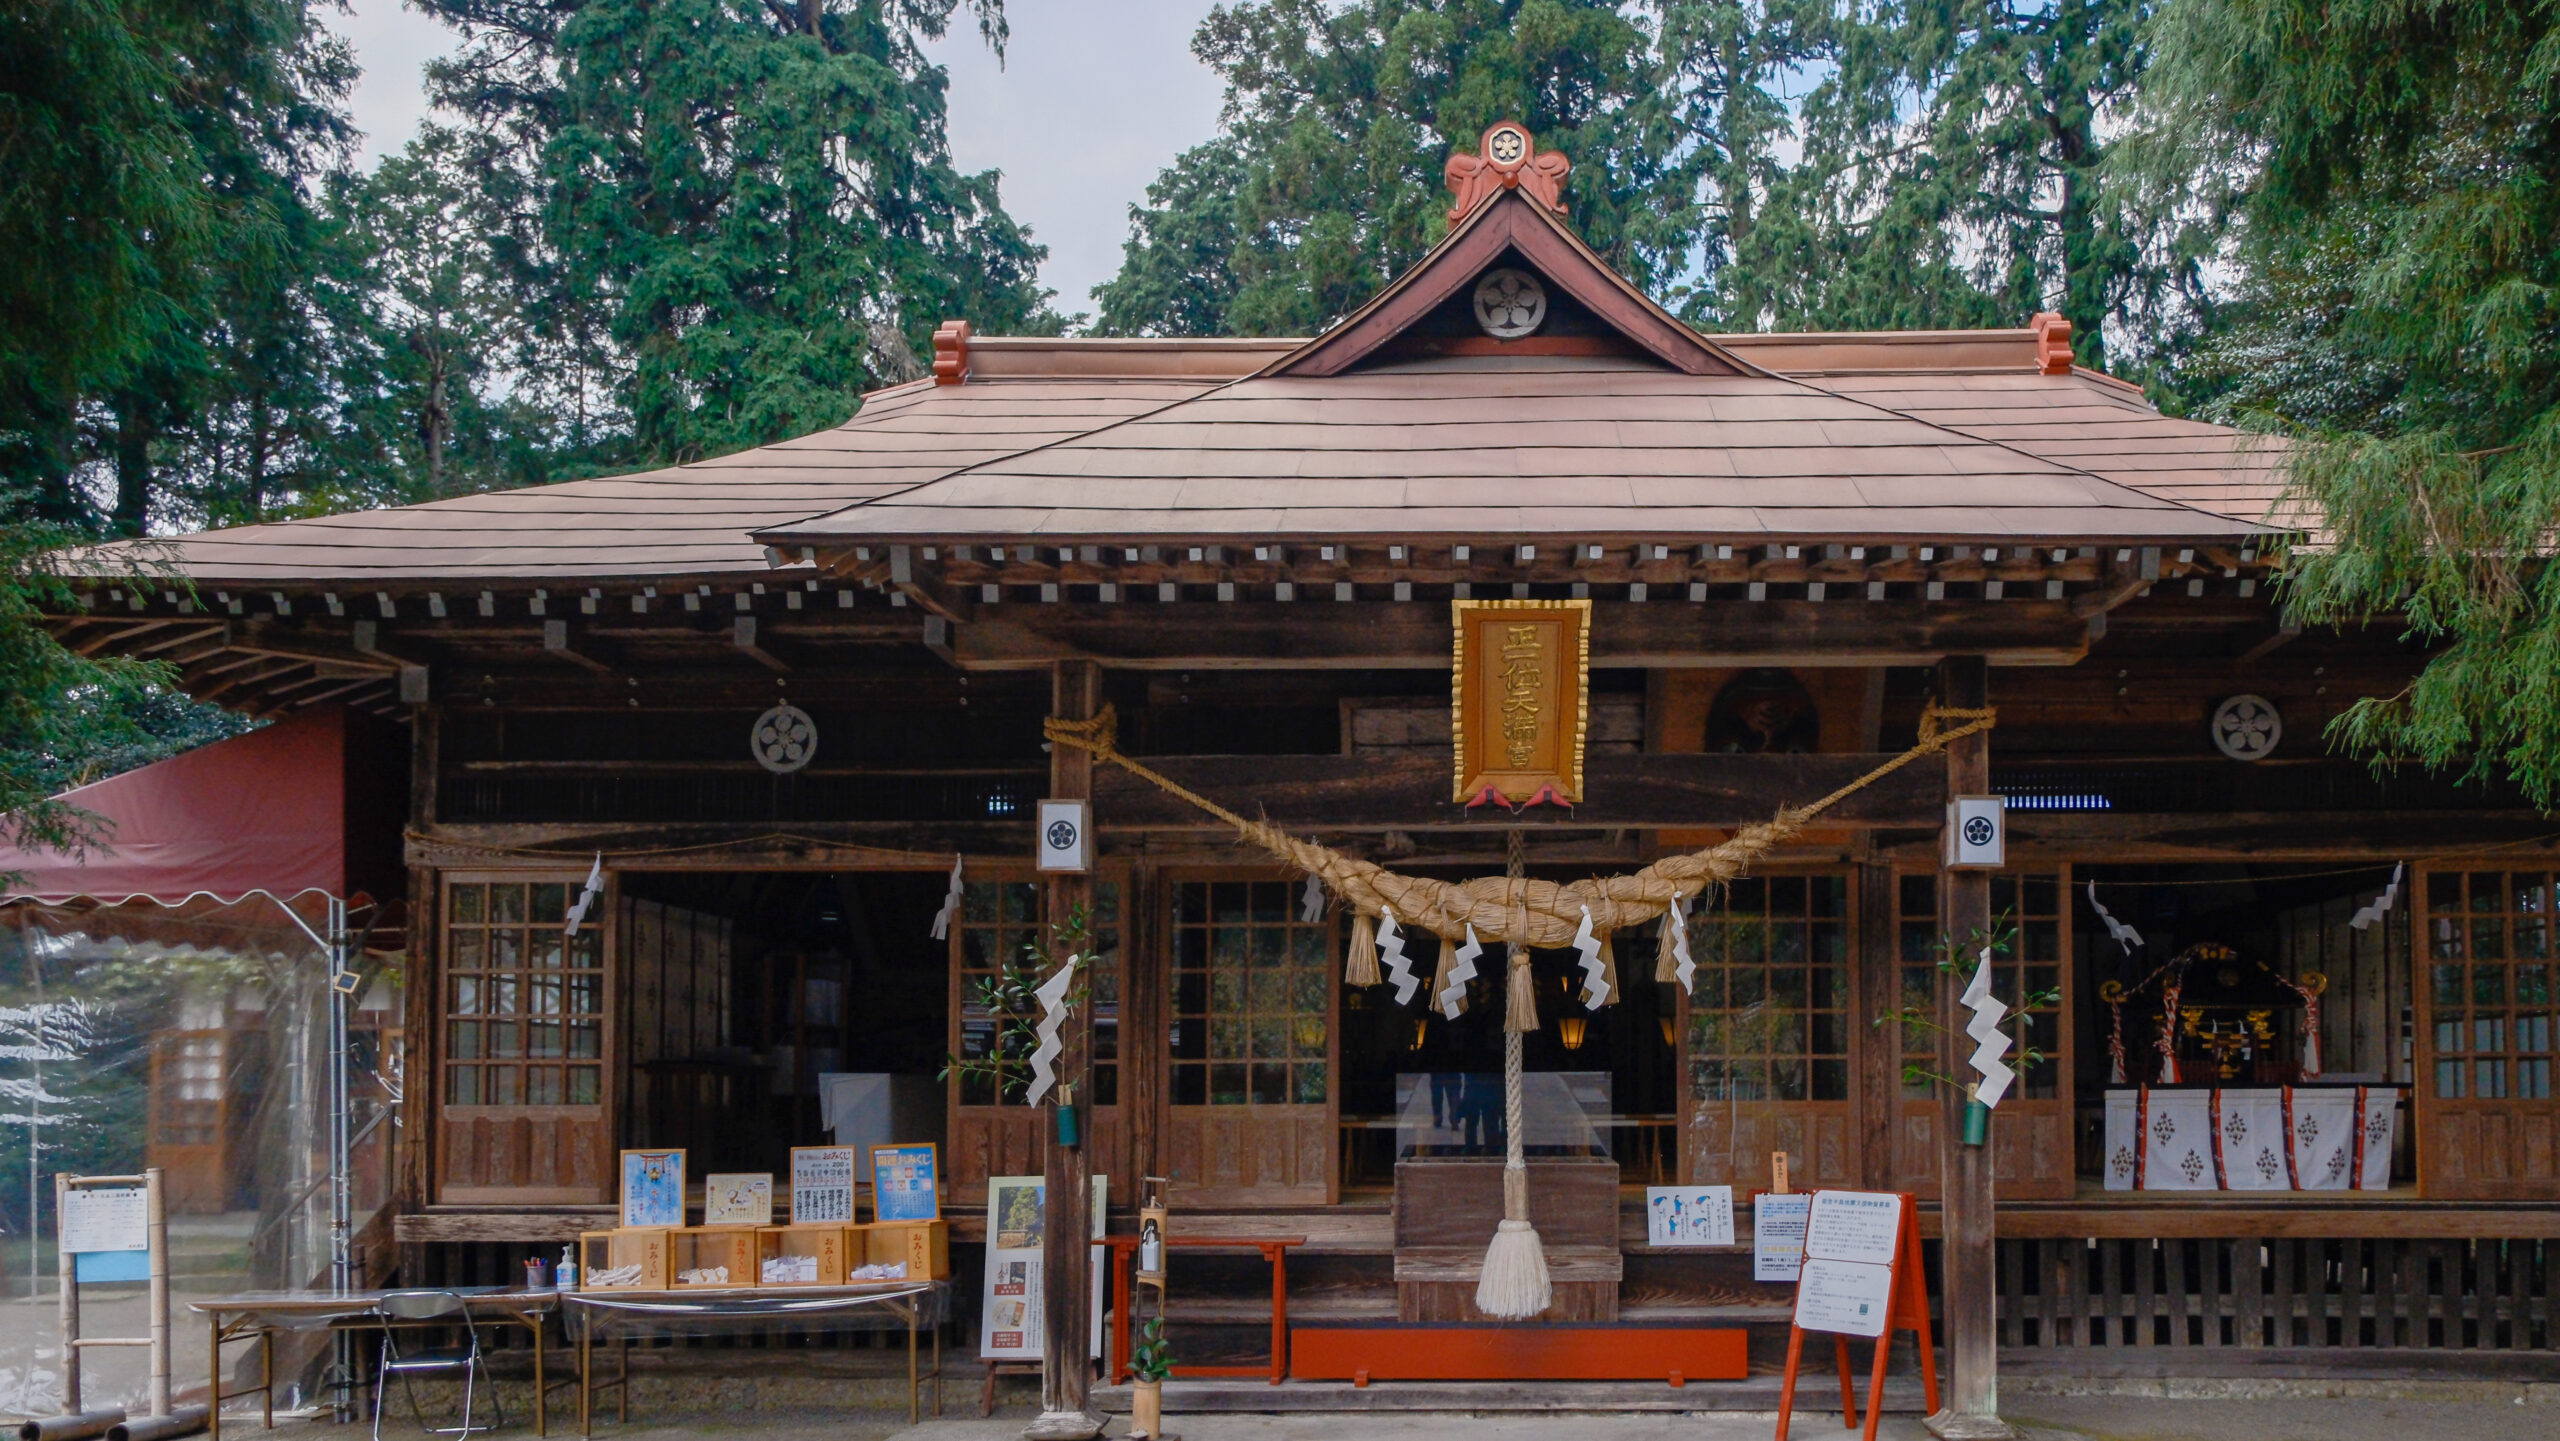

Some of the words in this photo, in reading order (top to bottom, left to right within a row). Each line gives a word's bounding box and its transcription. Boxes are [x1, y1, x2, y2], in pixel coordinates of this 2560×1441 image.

[1498, 625, 1543, 768] 正一位天満宮
[823, 1151, 851, 1160] おみくじ
[649, 1243, 658, 1278] おみくじ
[736, 1239, 745, 1274] おみくじ
[825, 1237, 834, 1274] おみくじ
[913, 1233, 923, 1270] おみくじ
